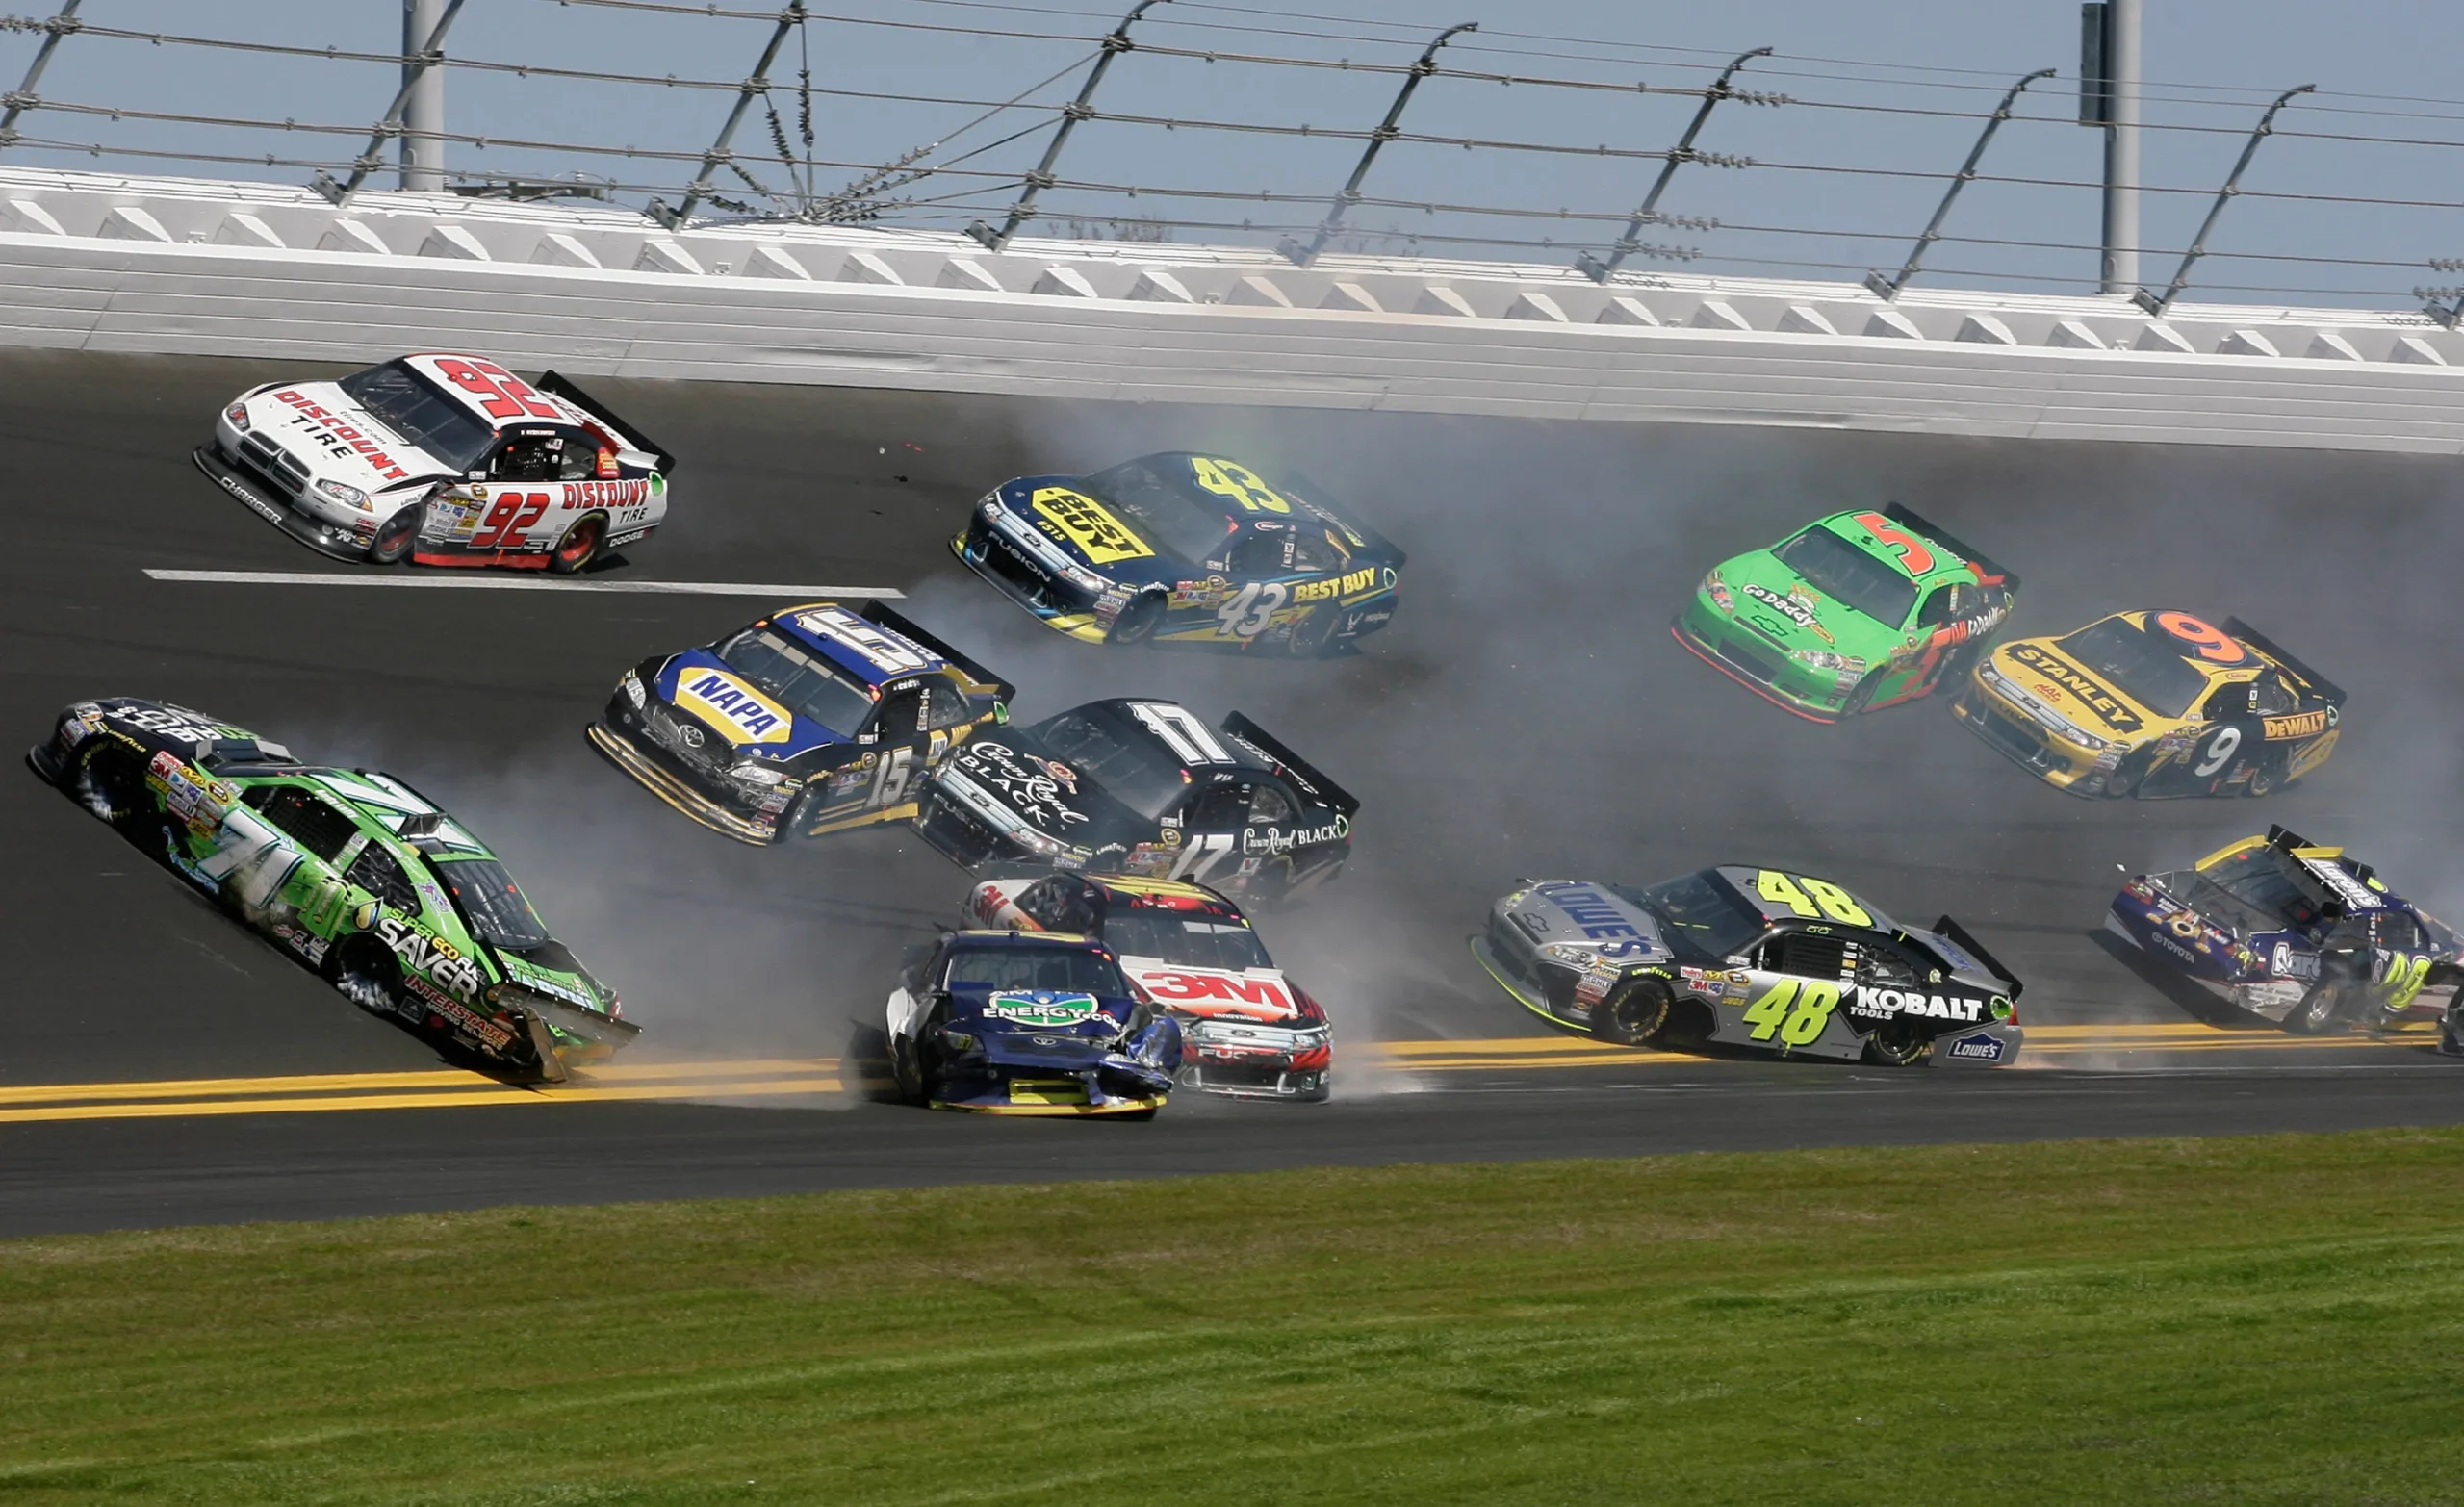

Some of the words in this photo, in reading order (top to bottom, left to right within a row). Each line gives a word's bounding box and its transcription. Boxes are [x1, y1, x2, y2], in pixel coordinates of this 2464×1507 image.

[434, 359, 562, 419] 92
[273, 390, 408, 481] DISCOUNT
[290, 415, 354, 459] TIRE
[220, 477, 282, 524] CHARGER
[562, 478, 649, 509] DISCOUNT
[1191, 457, 1291, 514] 43
[467, 492, 550, 549] 92
[608, 530, 644, 548] DODGE
[620, 507, 649, 524] TIRE
[1040, 498, 1119, 553] BUY
[1057, 494, 1142, 554] BEST
[988, 530, 1051, 582] FUSION
[1851, 512, 1936, 576] 5
[1216, 583, 1287, 637] 43
[1293, 577, 1341, 602] BEST
[1342, 567, 1376, 595] BUY
[796, 608, 928, 675] 15
[2157, 612, 2245, 662] 9
[690, 674, 780, 737] NAPA
[2017, 649, 2135, 722] STANLEY
[1126, 702, 1236, 766] 17
[2194, 728, 2241, 777] 9
[151, 760, 171, 779] 3M
[866, 746, 913, 807] 15
[959, 755, 1051, 827] BLACK
[971, 742, 1030, 779] Crown
[1009, 771, 1089, 825] Royal
[195, 806, 306, 907] 71
[1167, 834, 1234, 882] 17
[1243, 828, 1270, 855] Crown
[1262, 827, 1296, 856] Royal
[1298, 825, 1339, 845] BLACK
[1536, 881, 1652, 958] LOWE'S
[1756, 870, 1873, 930] 48
[374, 918, 478, 1004] SAVER
[389, 907, 435, 941] SUPER
[432, 936, 460, 960] ECO
[455, 956, 488, 985] FUEL
[2161, 936, 2195, 963] TOYOTA
[1142, 972, 1296, 1010] 3M
[1581, 974, 1612, 988] MAHLE
[1689, 980, 1707, 991] 3M
[1857, 985, 1983, 1022] KOBALT
[404, 973, 511, 1046] INTERSTATE
[425, 1002, 460, 1026] MOVING
[1743, 978, 1840, 1045] 48
[1850, 1007, 1894, 1020] TOOLS
[1953, 1041, 1999, 1058] LOWE'S
